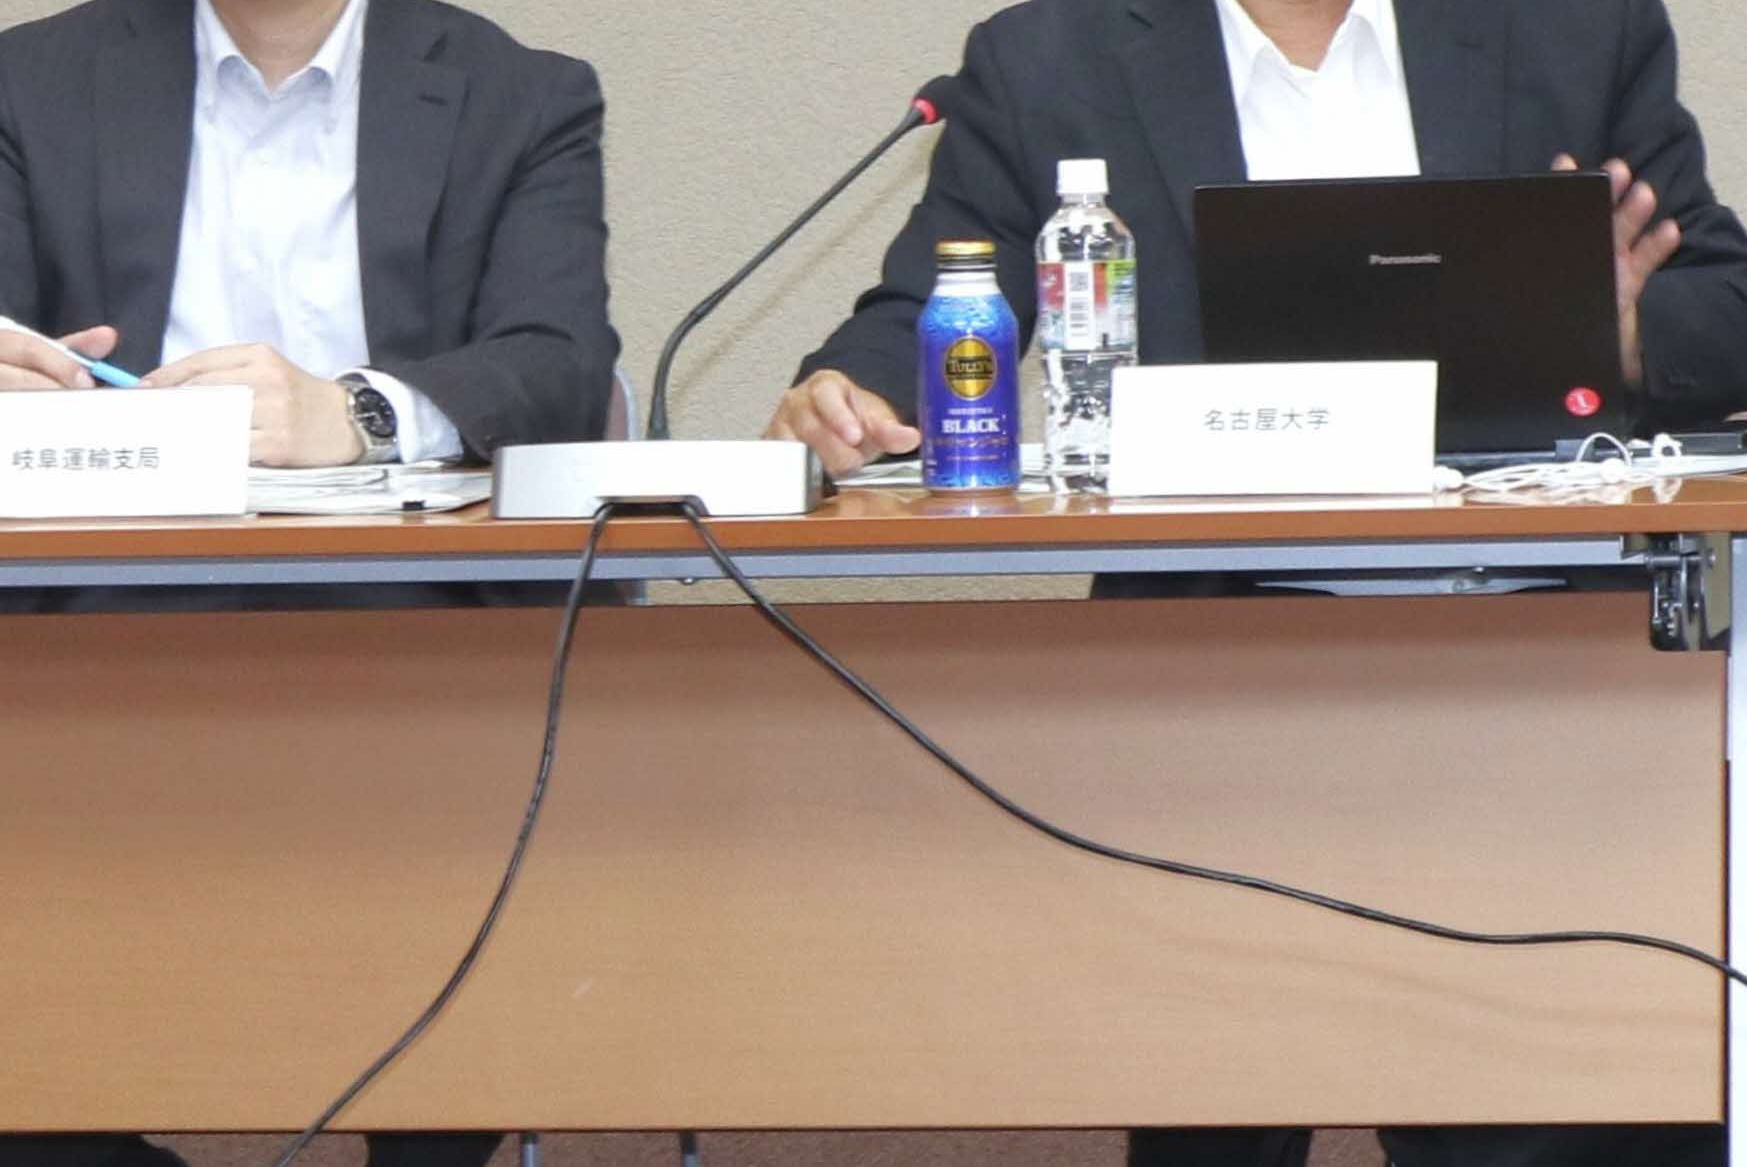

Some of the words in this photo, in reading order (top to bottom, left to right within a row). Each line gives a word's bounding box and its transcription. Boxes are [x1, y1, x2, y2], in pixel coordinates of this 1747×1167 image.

[1368, 253, 1442, 266] Panasonic
[941, 418, 1001, 434] BLACK
[1203, 407, 1330, 431] 名古屋大学
[12, 445, 160, 471] 岐阜運輸支局
